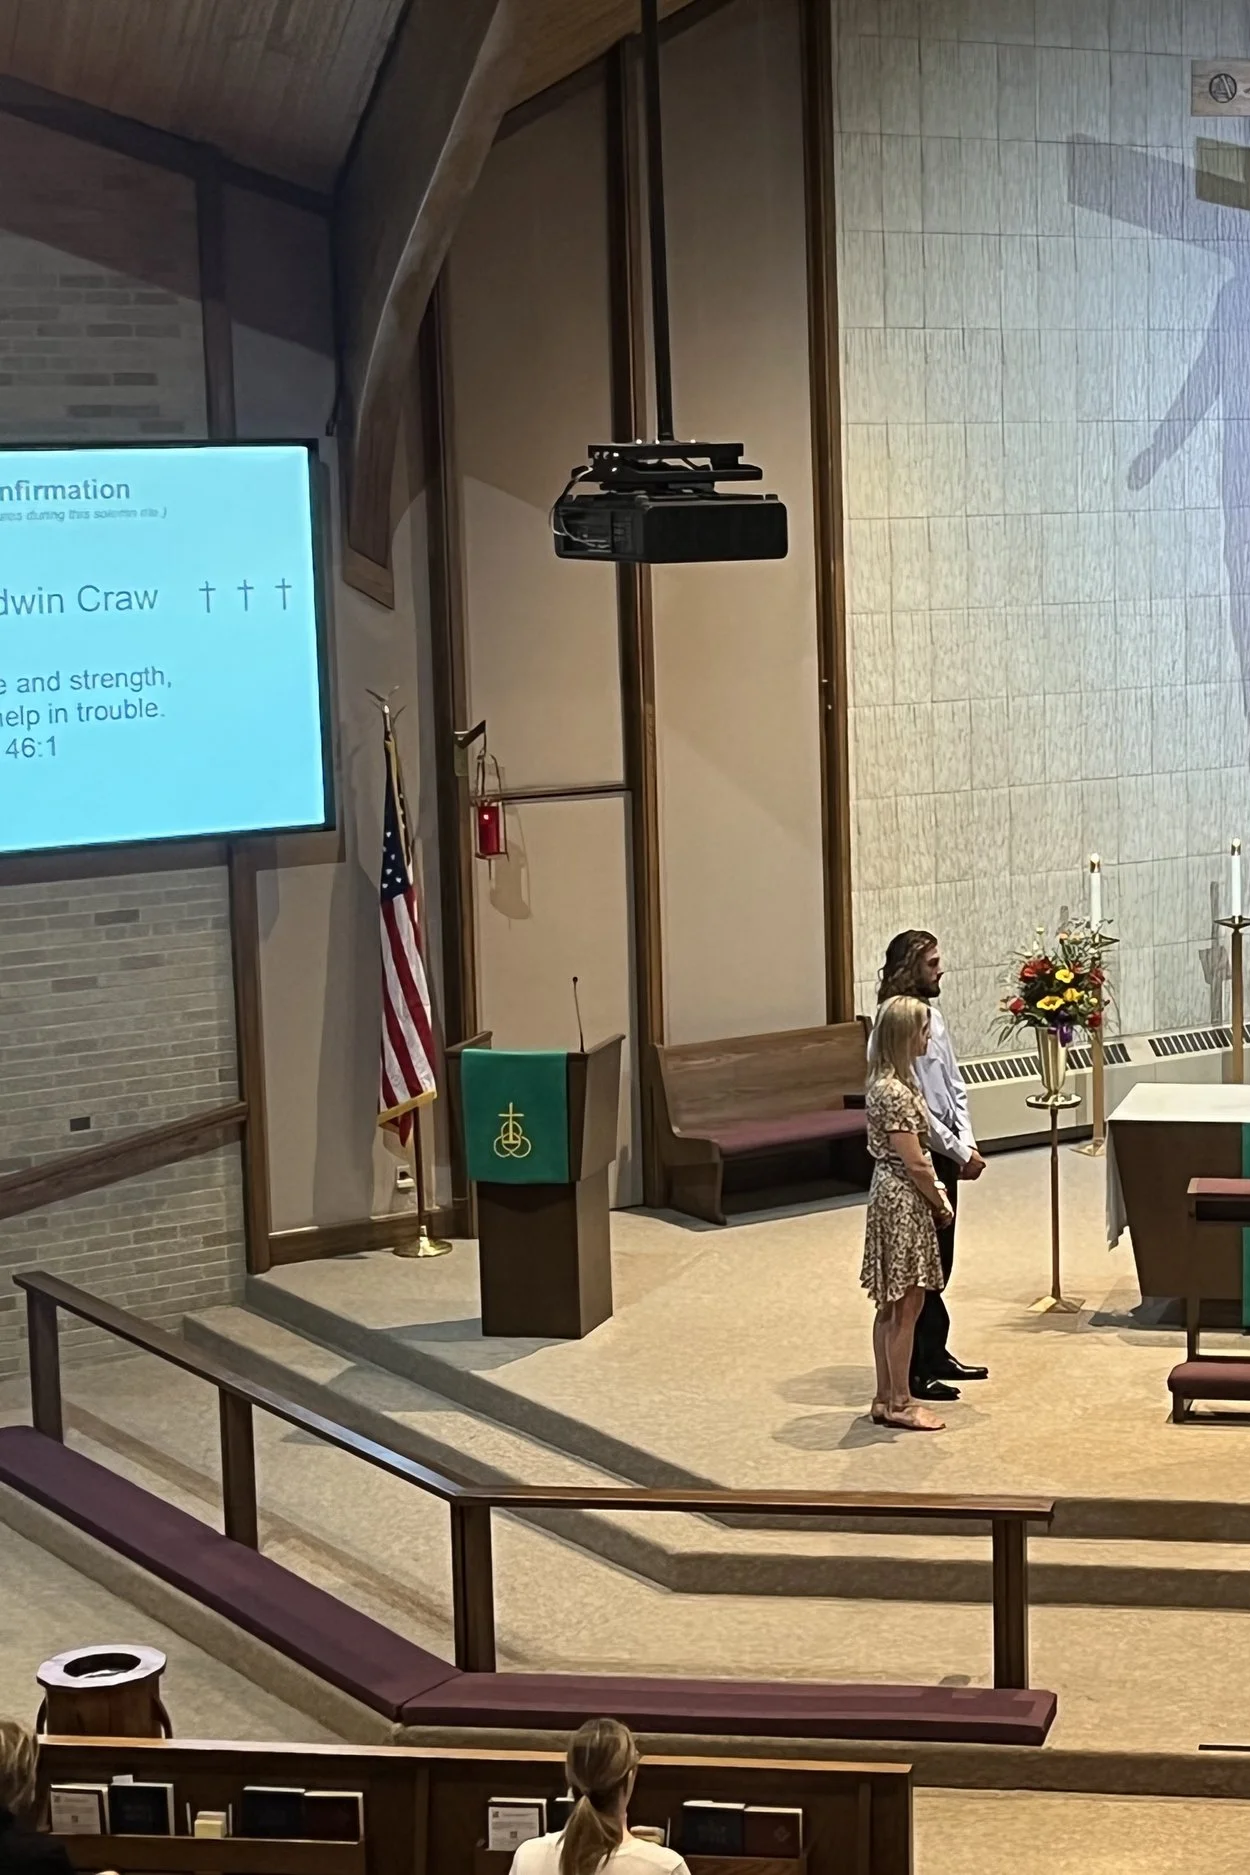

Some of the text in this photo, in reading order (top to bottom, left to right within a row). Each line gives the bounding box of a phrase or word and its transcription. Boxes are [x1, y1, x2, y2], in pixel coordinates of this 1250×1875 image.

[77, 584, 158, 612] Craw
[16, 670, 61, 694] and
[69, 665, 172, 693] strength,
[0, 697, 165, 732] elp in trouble.
[5, 735, 56, 759] 46:1
